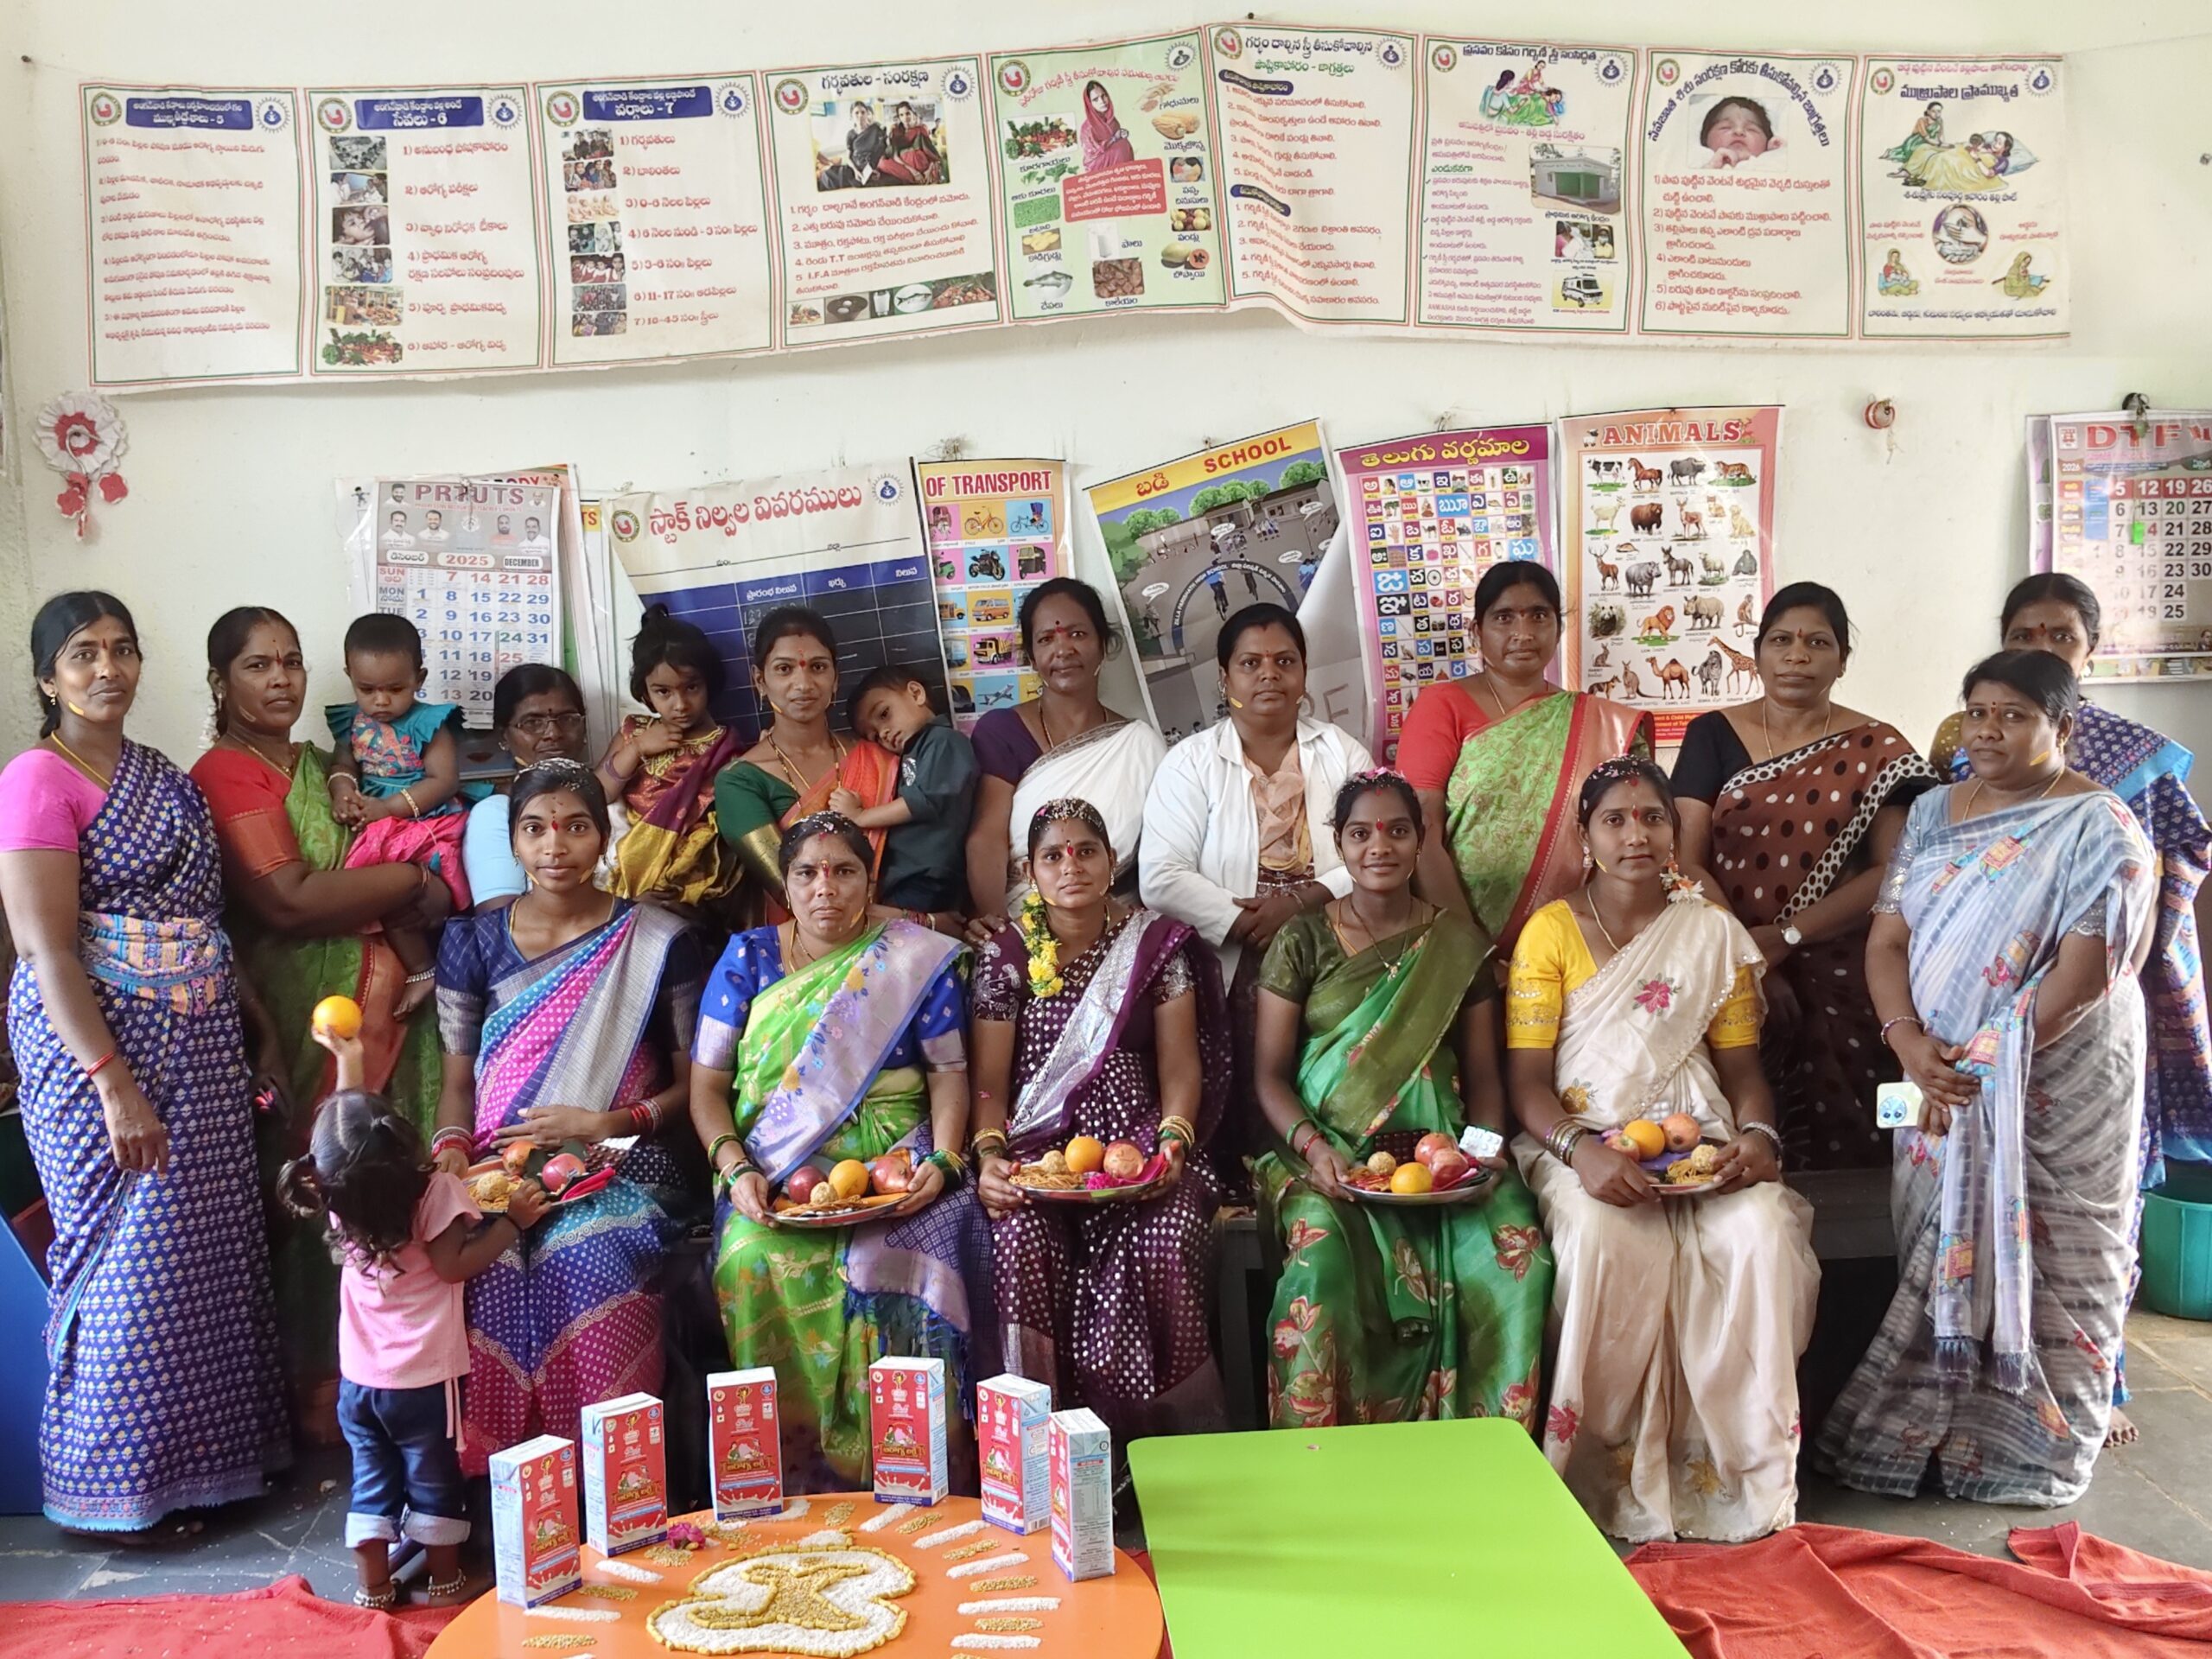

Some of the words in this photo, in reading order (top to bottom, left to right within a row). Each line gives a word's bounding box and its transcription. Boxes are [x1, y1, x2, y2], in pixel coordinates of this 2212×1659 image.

[883, 70, 929, 88] సంరక్షణ
[664, 102, 675, 114] 7
[437, 112, 448, 125] 6
[1603, 420, 1742, 446] ANIMALS
[1204, 436, 1293, 474] SCHOOL
[1360, 442, 1436, 468] తెలుగు
[1441, 435, 1530, 465] వర్ణమాల
[925, 476, 946, 498] OF
[953, 471, 1052, 495] TRANSPORT
[1136, 472, 1170, 497] బడి
[1364, 482, 1376, 491] అ
[1400, 477, 1414, 486] ఆ
[1436, 475, 1448, 486] ఇ
[1504, 470, 1516, 481] ఉ
[2138, 480, 2159, 494] 12
[2165, 480, 2186, 494] 19
[2191, 479, 2212, 493] 26
[1472, 496, 1484, 507] ఎ
[1507, 493, 1517, 505] ఏ
[649, 500, 691, 544] స్టాక్
[696, 501, 751, 538] నిల్వల
[754, 485, 862, 520] వివరములు
[2165, 501, 2185, 515] 20
[2191, 500, 2212, 514] 27
[1370, 528, 1382, 537] ఐ
[1406, 525, 1419, 536] ఒ
[1441, 521, 1453, 534] ఓ
[1474, 519, 1487, 531] ఔ
[1507, 518, 1521, 528] అం
[2165, 522, 2184, 536] 21
[1409, 547, 1421, 559] క
[1478, 544, 1489, 556] గ
[1513, 541, 1534, 556] ఘ
[2165, 543, 2184, 556] 22
[2191, 542, 2212, 556] 29
[446, 554, 489, 566] 2025
[505, 557, 540, 568] DECEMBER
[379, 567, 404, 576] SUN
[448, 571, 457, 582] 7
[471, 574, 491, 583] 14
[499, 574, 519, 584] 21
[527, 575, 549, 585] 28
[2165, 563, 2184, 577] 23
[2191, 563, 2211, 576] 30
[1377, 572, 1403, 592] జ
[1410, 569, 1424, 582] చ
[379, 587, 404, 596] MON
[446, 590, 457, 601] 8
[471, 592, 490, 602] 15
[498, 593, 521, 603] 22
[527, 594, 550, 604] 29
[2164, 584, 2184, 598] 24
[1414, 594, 1427, 607] ట
[469, 612, 492, 622] 16
[498, 612, 520, 622] 23
[527, 613, 550, 624] 30
[2164, 605, 2184, 618] 25
[1416, 616, 1428, 629] త
[440, 631, 462, 641] 10
[469, 632, 492, 642] 17
[500, 632, 522, 643] 24
[527, 633, 549, 643] 31
[1384, 644, 1396, 656] న
[1418, 641, 1430, 653] ప
[499, 653, 523, 664] 25
[1453, 662, 1464, 675] ర
[470, 671, 492, 682] 19
[469, 691, 493, 701] 20
